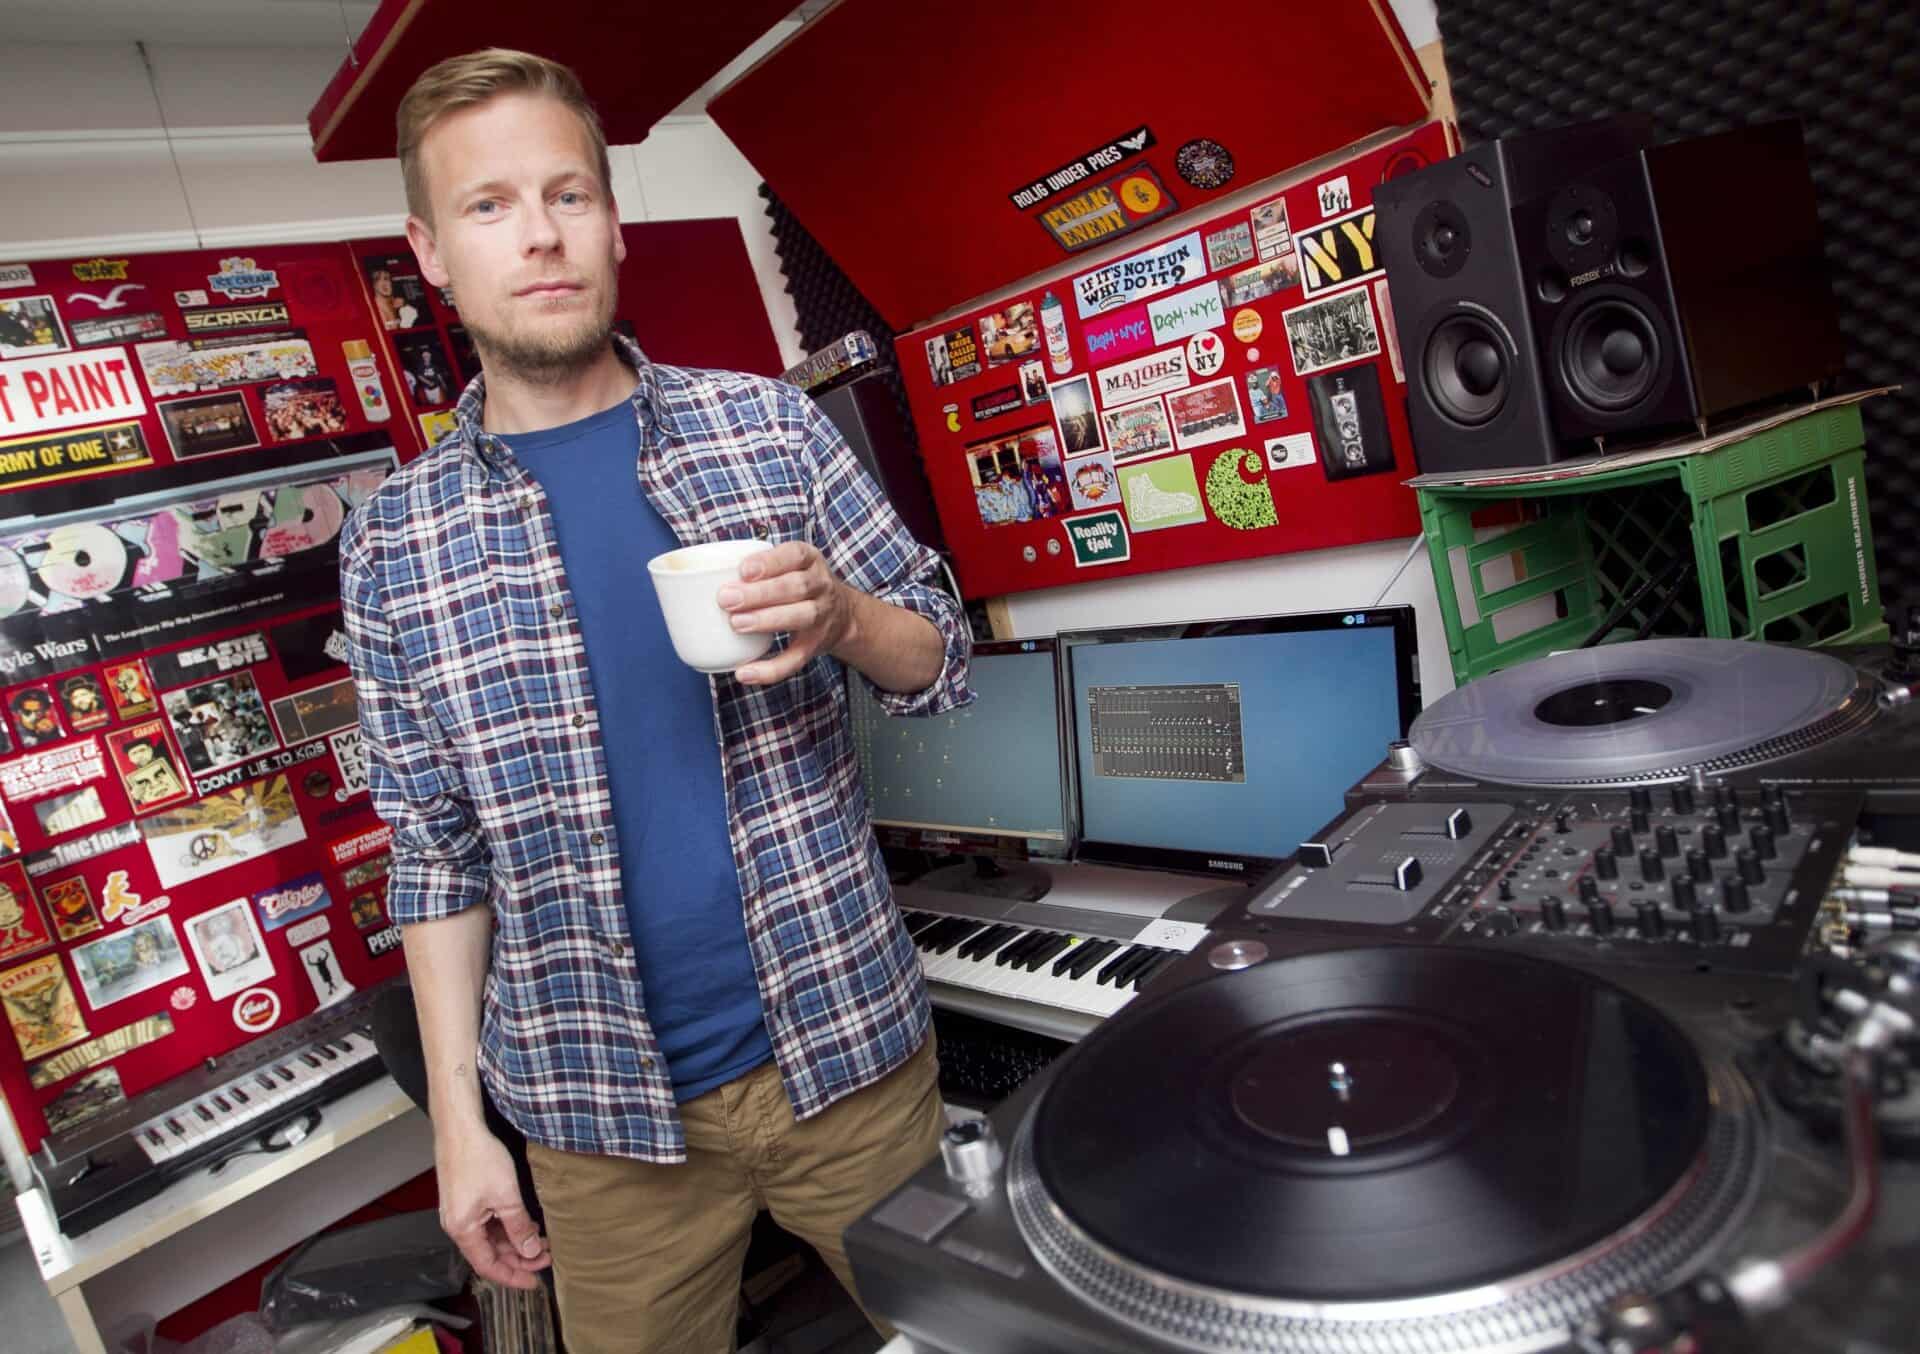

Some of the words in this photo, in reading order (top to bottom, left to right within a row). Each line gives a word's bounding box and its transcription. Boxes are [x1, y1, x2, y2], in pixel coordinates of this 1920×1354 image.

[1013, 183, 1049, 209] ROLIG
[1046, 162, 1090, 191] UNDER
[1087, 145, 1122, 171] PRES
[1043, 186, 1116, 228] PUBLIC
[1059, 209, 1126, 247] ENEMY
[1302, 213, 1376, 288] NY
[1080, 277, 1094, 294] IF
[1096, 265, 1121, 285] IT'S
[1124, 259, 1155, 277] NOT
[1158, 244, 1191, 270] FUN
[1570, 266, 1601, 287] FOSTEX
[1084, 280, 1120, 306] WHY
[1124, 276, 1147, 291] DO
[185, 306, 288, 329] SCRATCH
[950, 344, 976, 359] CALLED
[952, 352, 976, 367] QUEST
[1195, 353, 1217, 371] NY
[1106, 357, 1183, 390] MAJORS
[22, 359, 132, 418] PAINT
[40, 446, 63, 467] OF
[67, 440, 106, 462] ONE
[1073, 521, 1118, 540] Reality
[1086, 535, 1113, 554] tjek
[34, 639, 88, 660] Wars
[177, 633, 265, 668] BEASTIE
[217, 647, 269, 671] BOYS
[132, 722, 161, 738] GIANT
[249, 759, 271, 776] LIE
[275, 753, 294, 767] TO
[295, 741, 327, 762] KIDS
[1208, 859, 1244, 871] SAMSUNG
[1, 963, 56, 990] OBEY
